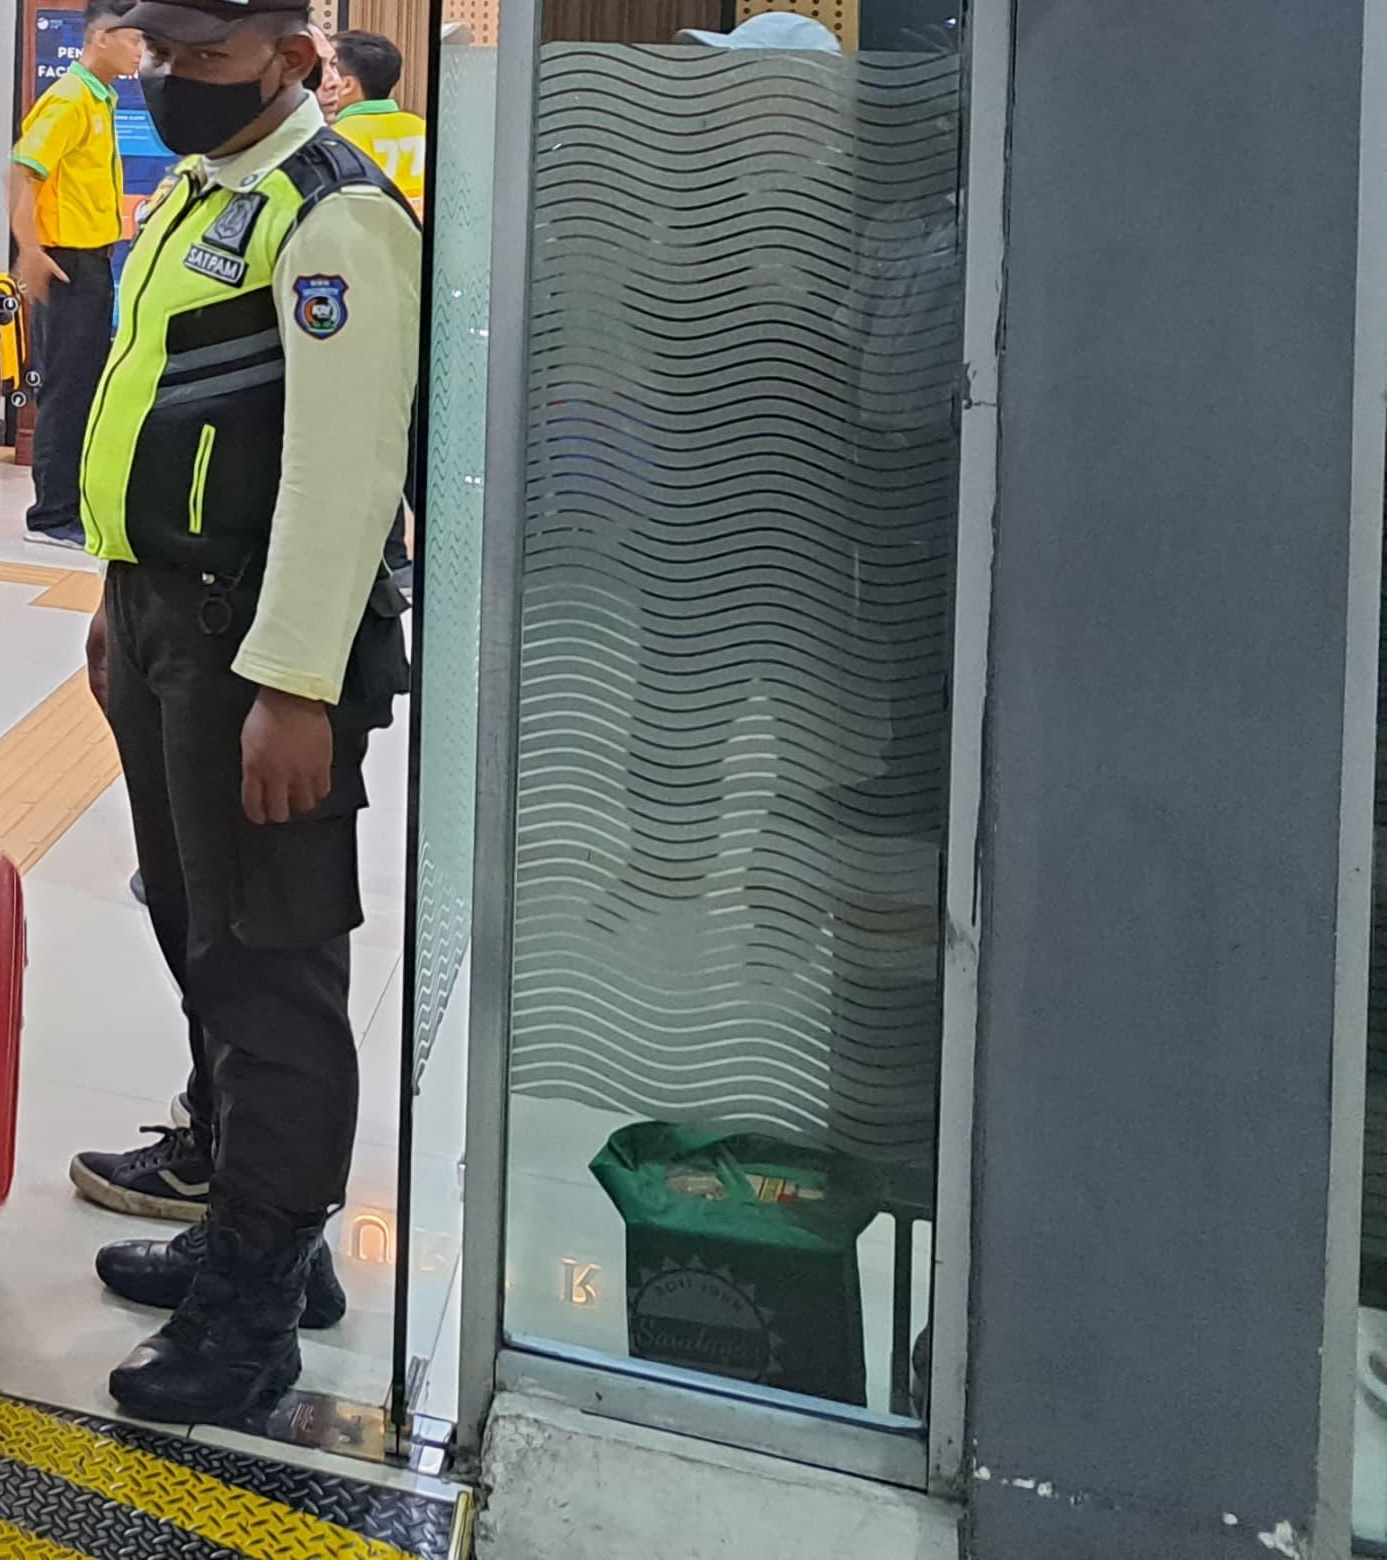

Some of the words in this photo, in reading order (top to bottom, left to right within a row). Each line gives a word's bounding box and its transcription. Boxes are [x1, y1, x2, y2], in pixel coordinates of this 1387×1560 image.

[58, 47, 85, 58] PEN
[38, 66, 68, 78] FAC
[187, 246, 239, 280] SATPAM
